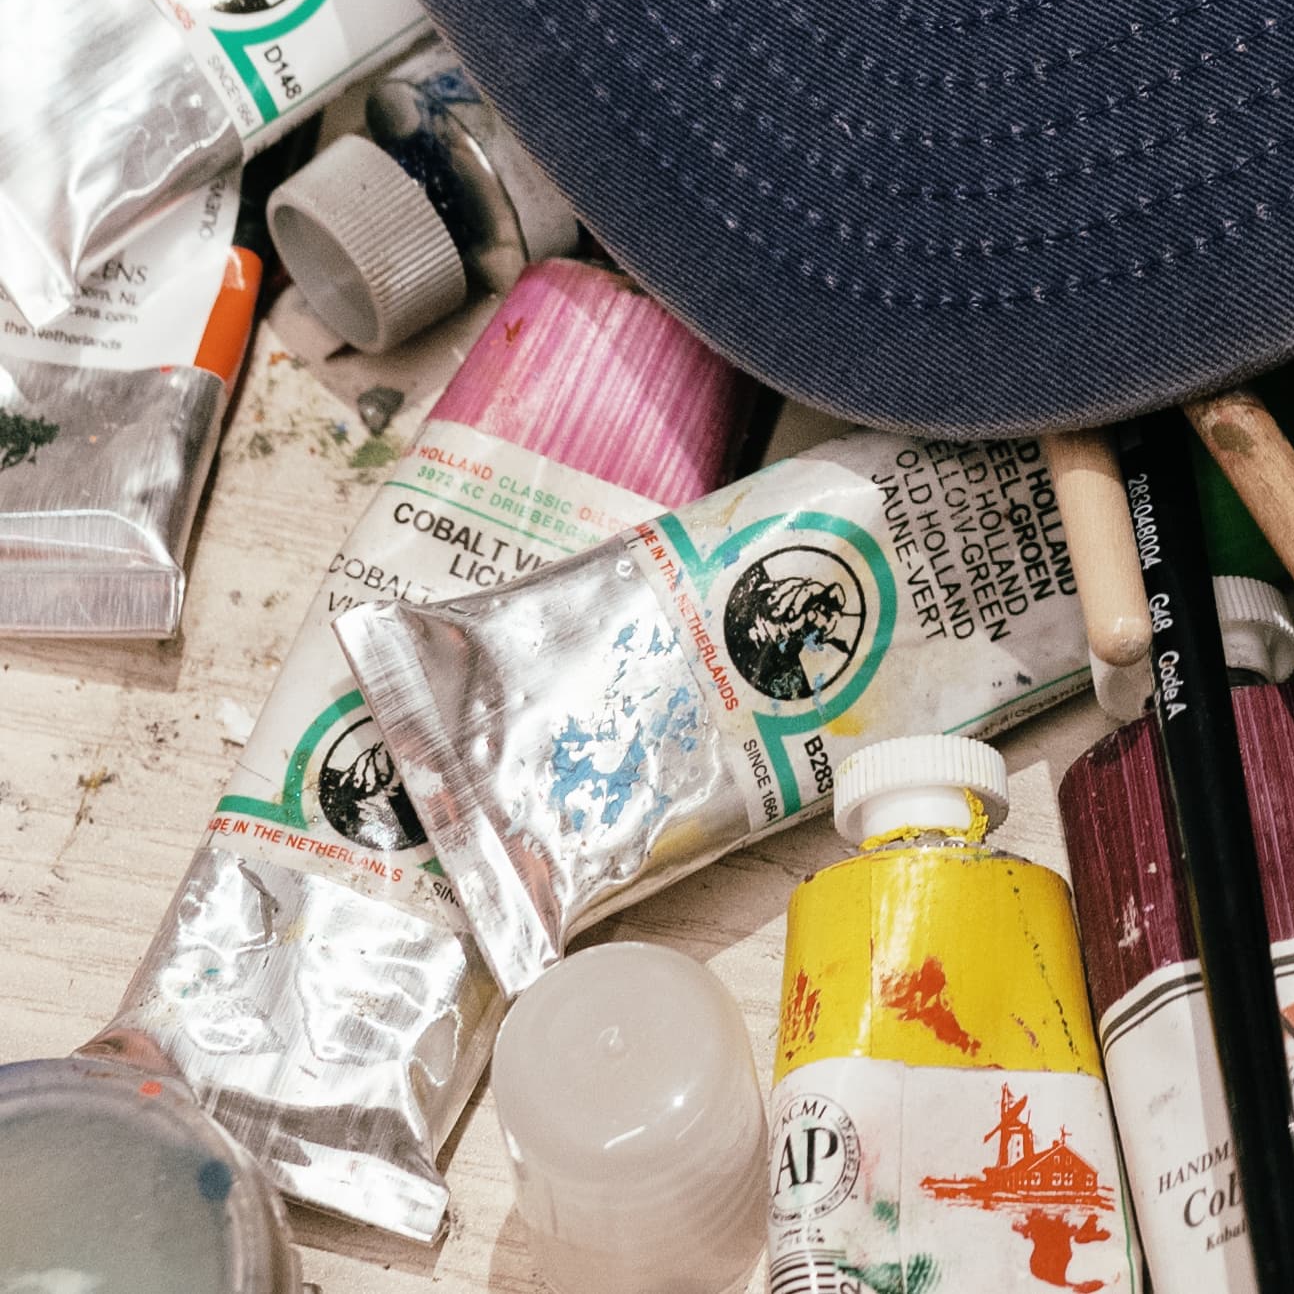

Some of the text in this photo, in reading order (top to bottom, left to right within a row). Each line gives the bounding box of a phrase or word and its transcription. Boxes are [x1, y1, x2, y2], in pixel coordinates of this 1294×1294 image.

[263, 45, 303, 100] D148
[418, 446, 493, 481] HOLLAND
[499, 476, 573, 515] CLASSIC
[460, 482, 484, 500] KC
[393, 502, 510, 562] COBALT
[650, 540, 667, 561] IN
[896, 449, 976, 641] OLD HOLLAND
[924, 441, 1012, 643] ELLOW-GREEN
[976, 489, 1029, 616] HOLLAND
[985, 442, 1057, 602] EEL-GROEN
[1026, 467, 1078, 596] HOLLAND
[1127, 473, 1163, 571] 283048004
[871, 474, 948, 641] JAUNE-VERT
[1158, 650, 1185, 701] Code
[1167, 702, 1188, 721] A
[743, 739, 780, 824] SINCE 1664
[804, 734, 835, 795] B283
[232, 818, 249, 835] IN
[253, 825, 282, 843] THE
[285, 832, 404, 883] NETHERLANDS
[432, 882, 461, 909] SIN
[773, 1126, 838, 1198] AP
[1158, 1139, 1232, 1195] HANDM
[1183, 1172, 1244, 1229] Cob
